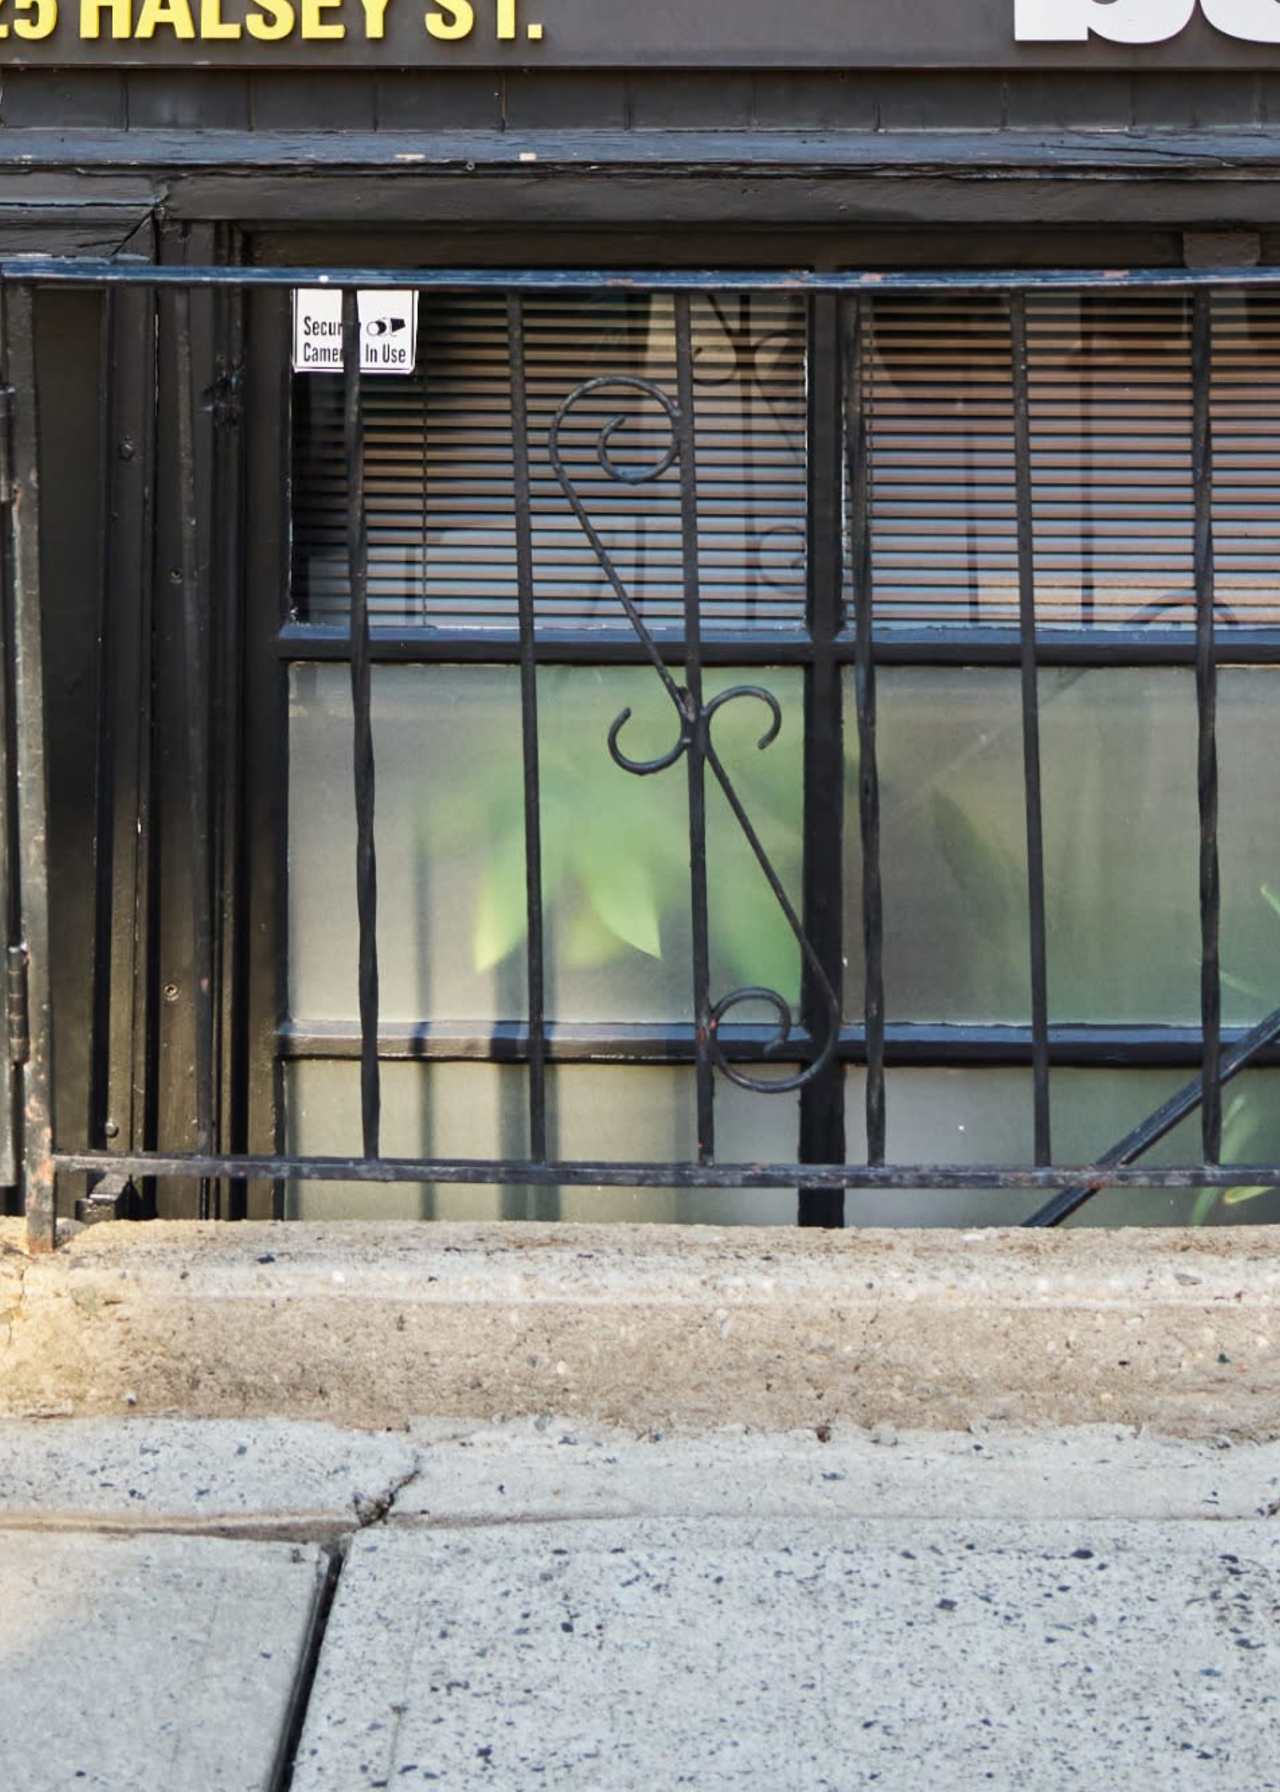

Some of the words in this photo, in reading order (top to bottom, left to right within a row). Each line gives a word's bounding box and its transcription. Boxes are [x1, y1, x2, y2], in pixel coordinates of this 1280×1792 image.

[303, 316, 343, 336] Secur
[365, 343, 378, 362] In
[382, 343, 406, 363] Use
